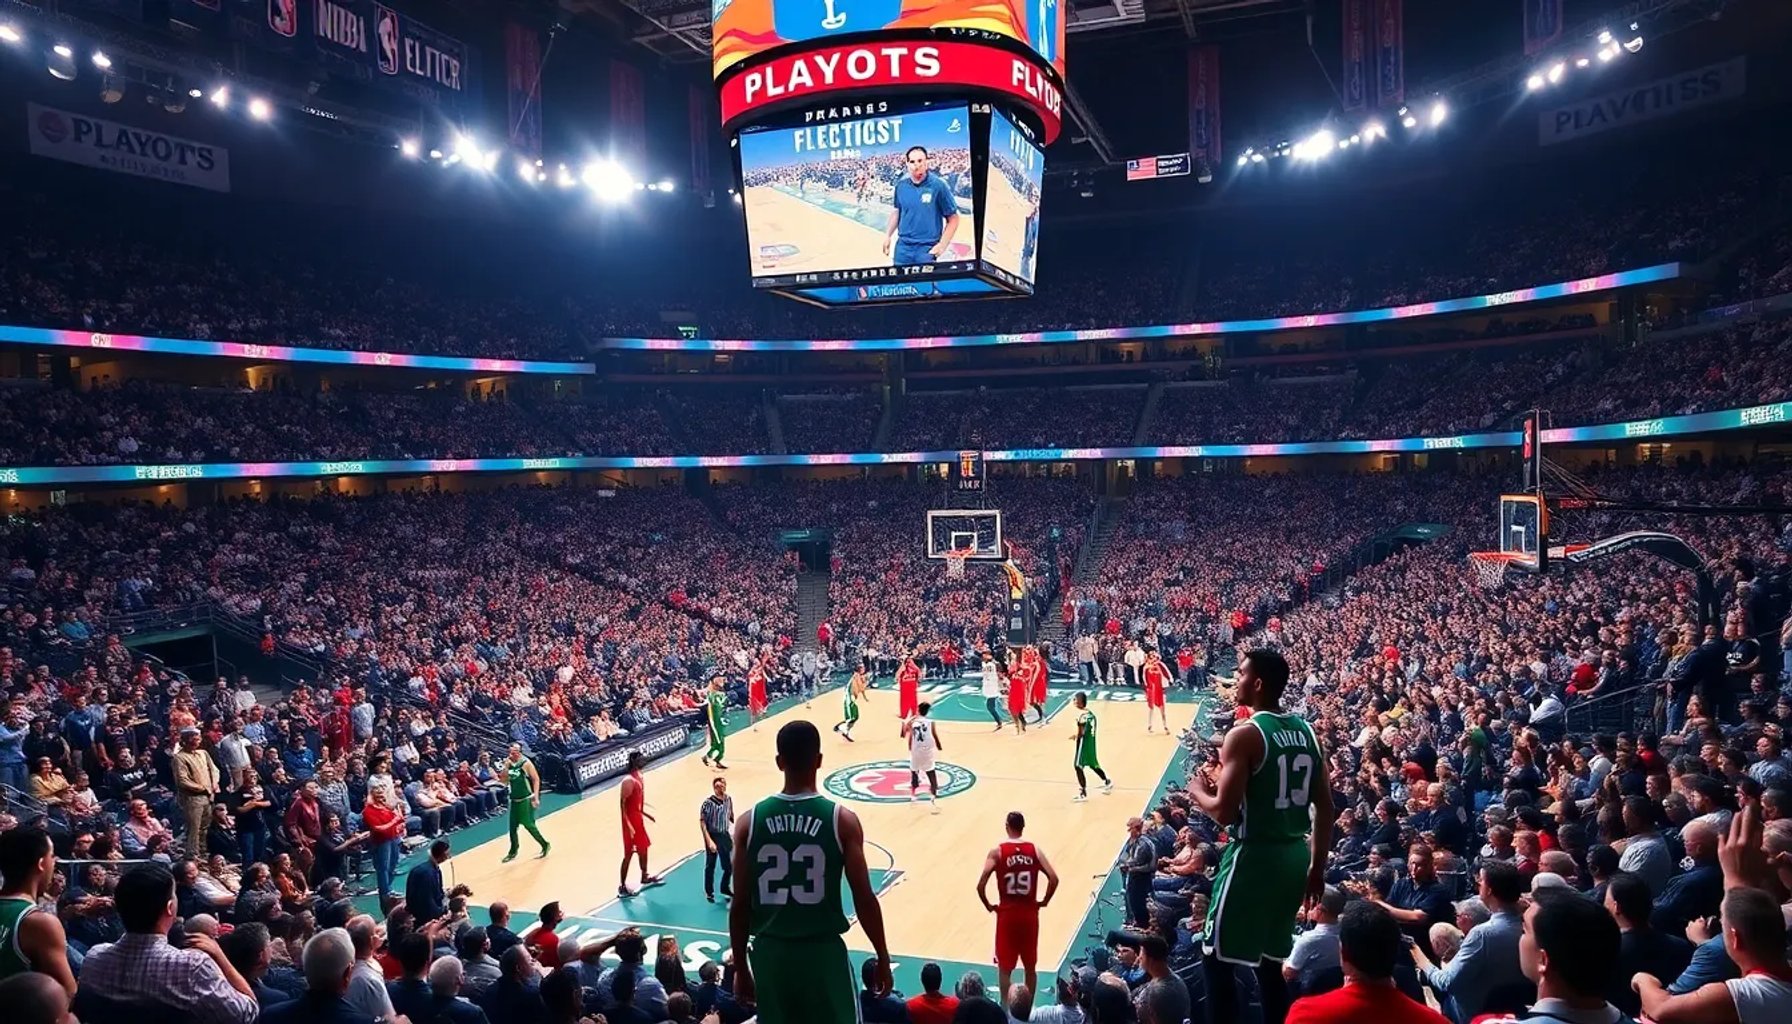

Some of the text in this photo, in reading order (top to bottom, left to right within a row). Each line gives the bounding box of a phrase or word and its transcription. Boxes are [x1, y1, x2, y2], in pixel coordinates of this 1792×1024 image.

[745, 46, 941, 104] PLAYOTS
[72, 117, 215, 172] PLAYOTS
[757, 844, 826, 905] 23
